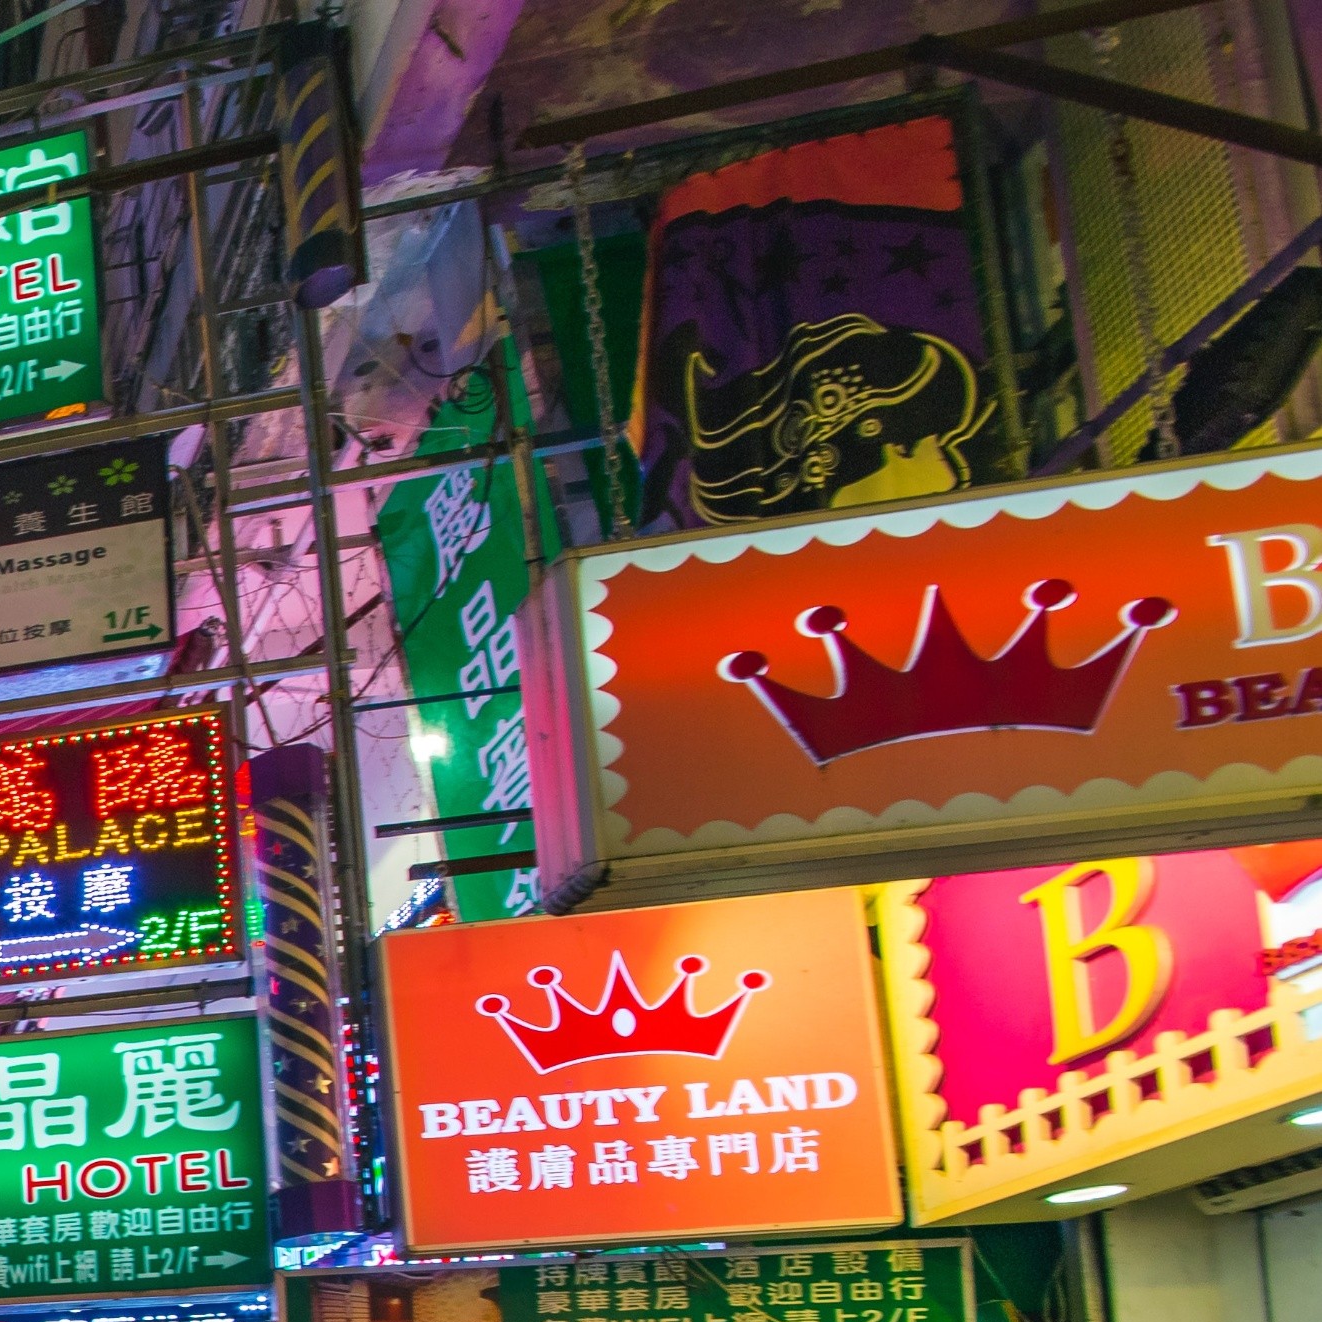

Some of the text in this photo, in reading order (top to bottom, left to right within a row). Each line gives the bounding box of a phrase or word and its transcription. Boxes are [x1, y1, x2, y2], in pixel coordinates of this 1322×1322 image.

[103, 605, 152, 629] 1/F
[138, 907, 221, 952] 2/F
[420, 1071, 859, 1141] BEAUTY LAND
[22, 1149, 250, 1206] HOTEL
[466, 1127, 821, 1197] 護膚品專門店
[90, 1203, 253, 1241] 歡迎自由行
[725, 1246, 925, 1280] 酒店設備
[536, 1285, 691, 1314] 豪華套房
